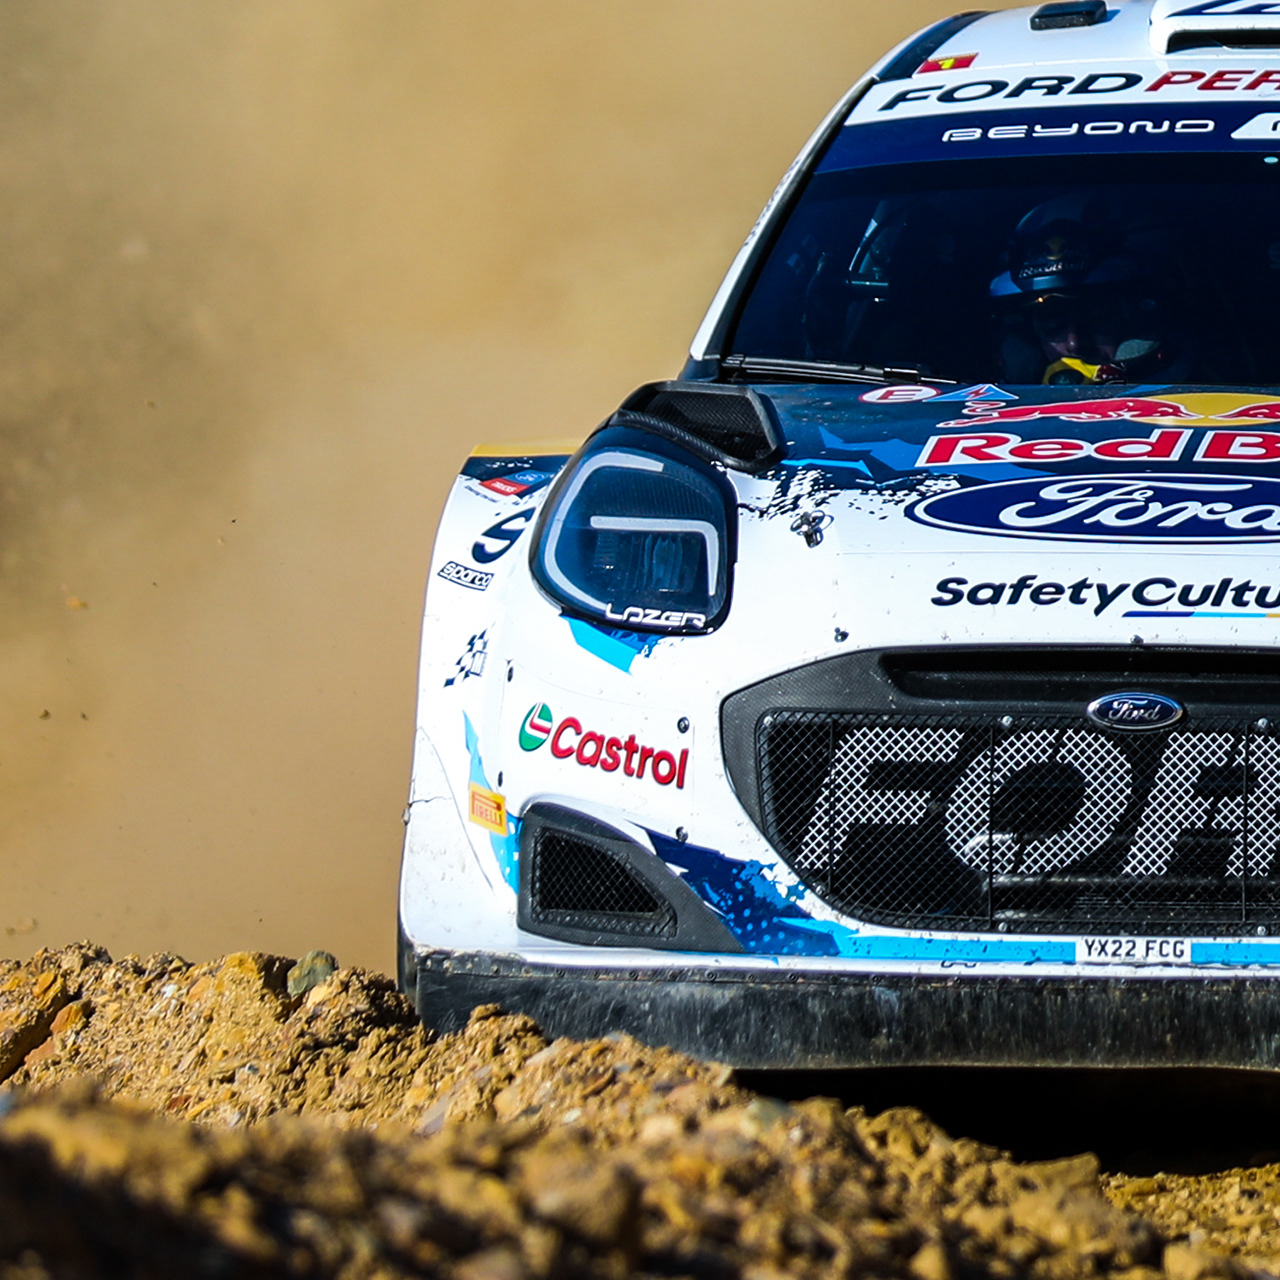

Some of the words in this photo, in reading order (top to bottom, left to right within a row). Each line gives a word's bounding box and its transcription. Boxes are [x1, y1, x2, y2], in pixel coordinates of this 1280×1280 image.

[878, 72, 1143, 111] FORD
[942, 119, 1215, 142] BEYOND
[915, 428, 1194, 467] Red
[440, 563, 491, 589] sparco
[605, 602, 706, 628] LAZER
[1107, 698, 1161, 720] Ford
[550, 716, 689, 789] Castrol
[471, 790, 504, 828] PIRELLI
[1085, 939, 1136, 958] YX22
[1145, 939, 1185, 958] FCG
